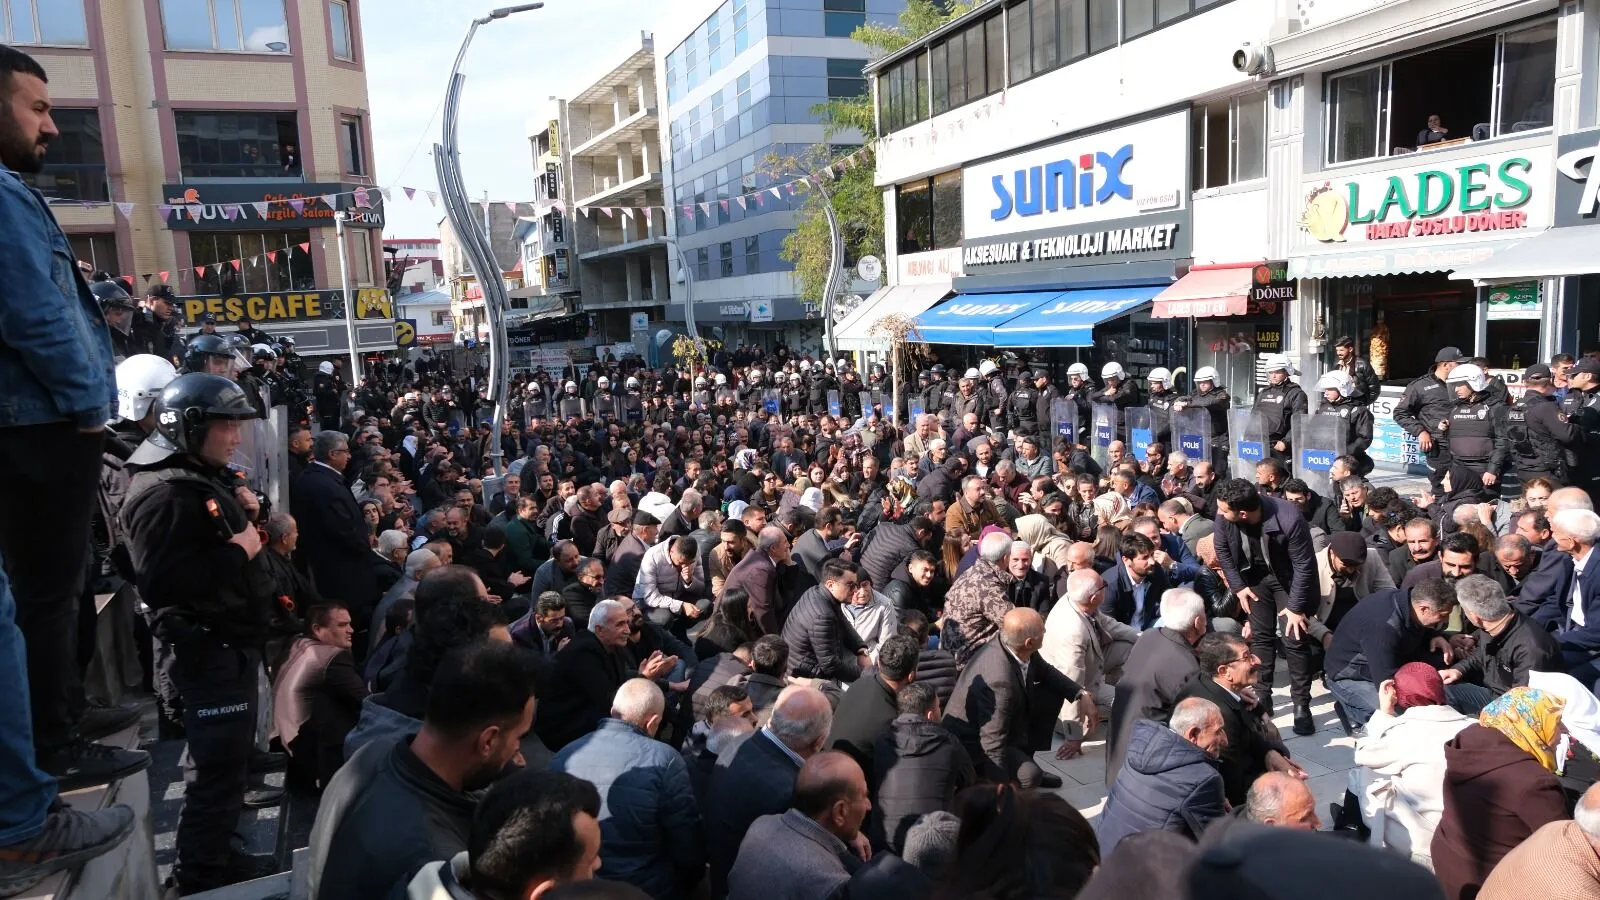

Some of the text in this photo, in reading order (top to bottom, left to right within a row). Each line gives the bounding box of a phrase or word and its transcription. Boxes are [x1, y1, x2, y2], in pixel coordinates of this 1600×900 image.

[1345, 157, 1532, 223] LADES
[257, 207, 296, 220] argile
[1365, 210, 1527, 240] HATAY SOSLU DÖNER
[964, 241, 1018, 265] AKSESUAR
[1021, 240, 1031, 261] &
[1107, 223, 1178, 254] MARKET
[1256, 285, 1294, 299] DÖNER
[185, 293, 322, 323] PES CAFE
[1257, 331, 1280, 342] LADES
[1183, 441, 1199, 449] POLİS
[1402, 445, 1417, 453] 175
[1242, 447, 1259, 456] POLİS
[1308, 456, 1330, 465] POLİS
[1402, 455, 1416, 463] 175
[220, 702, 249, 714] KUVVET
